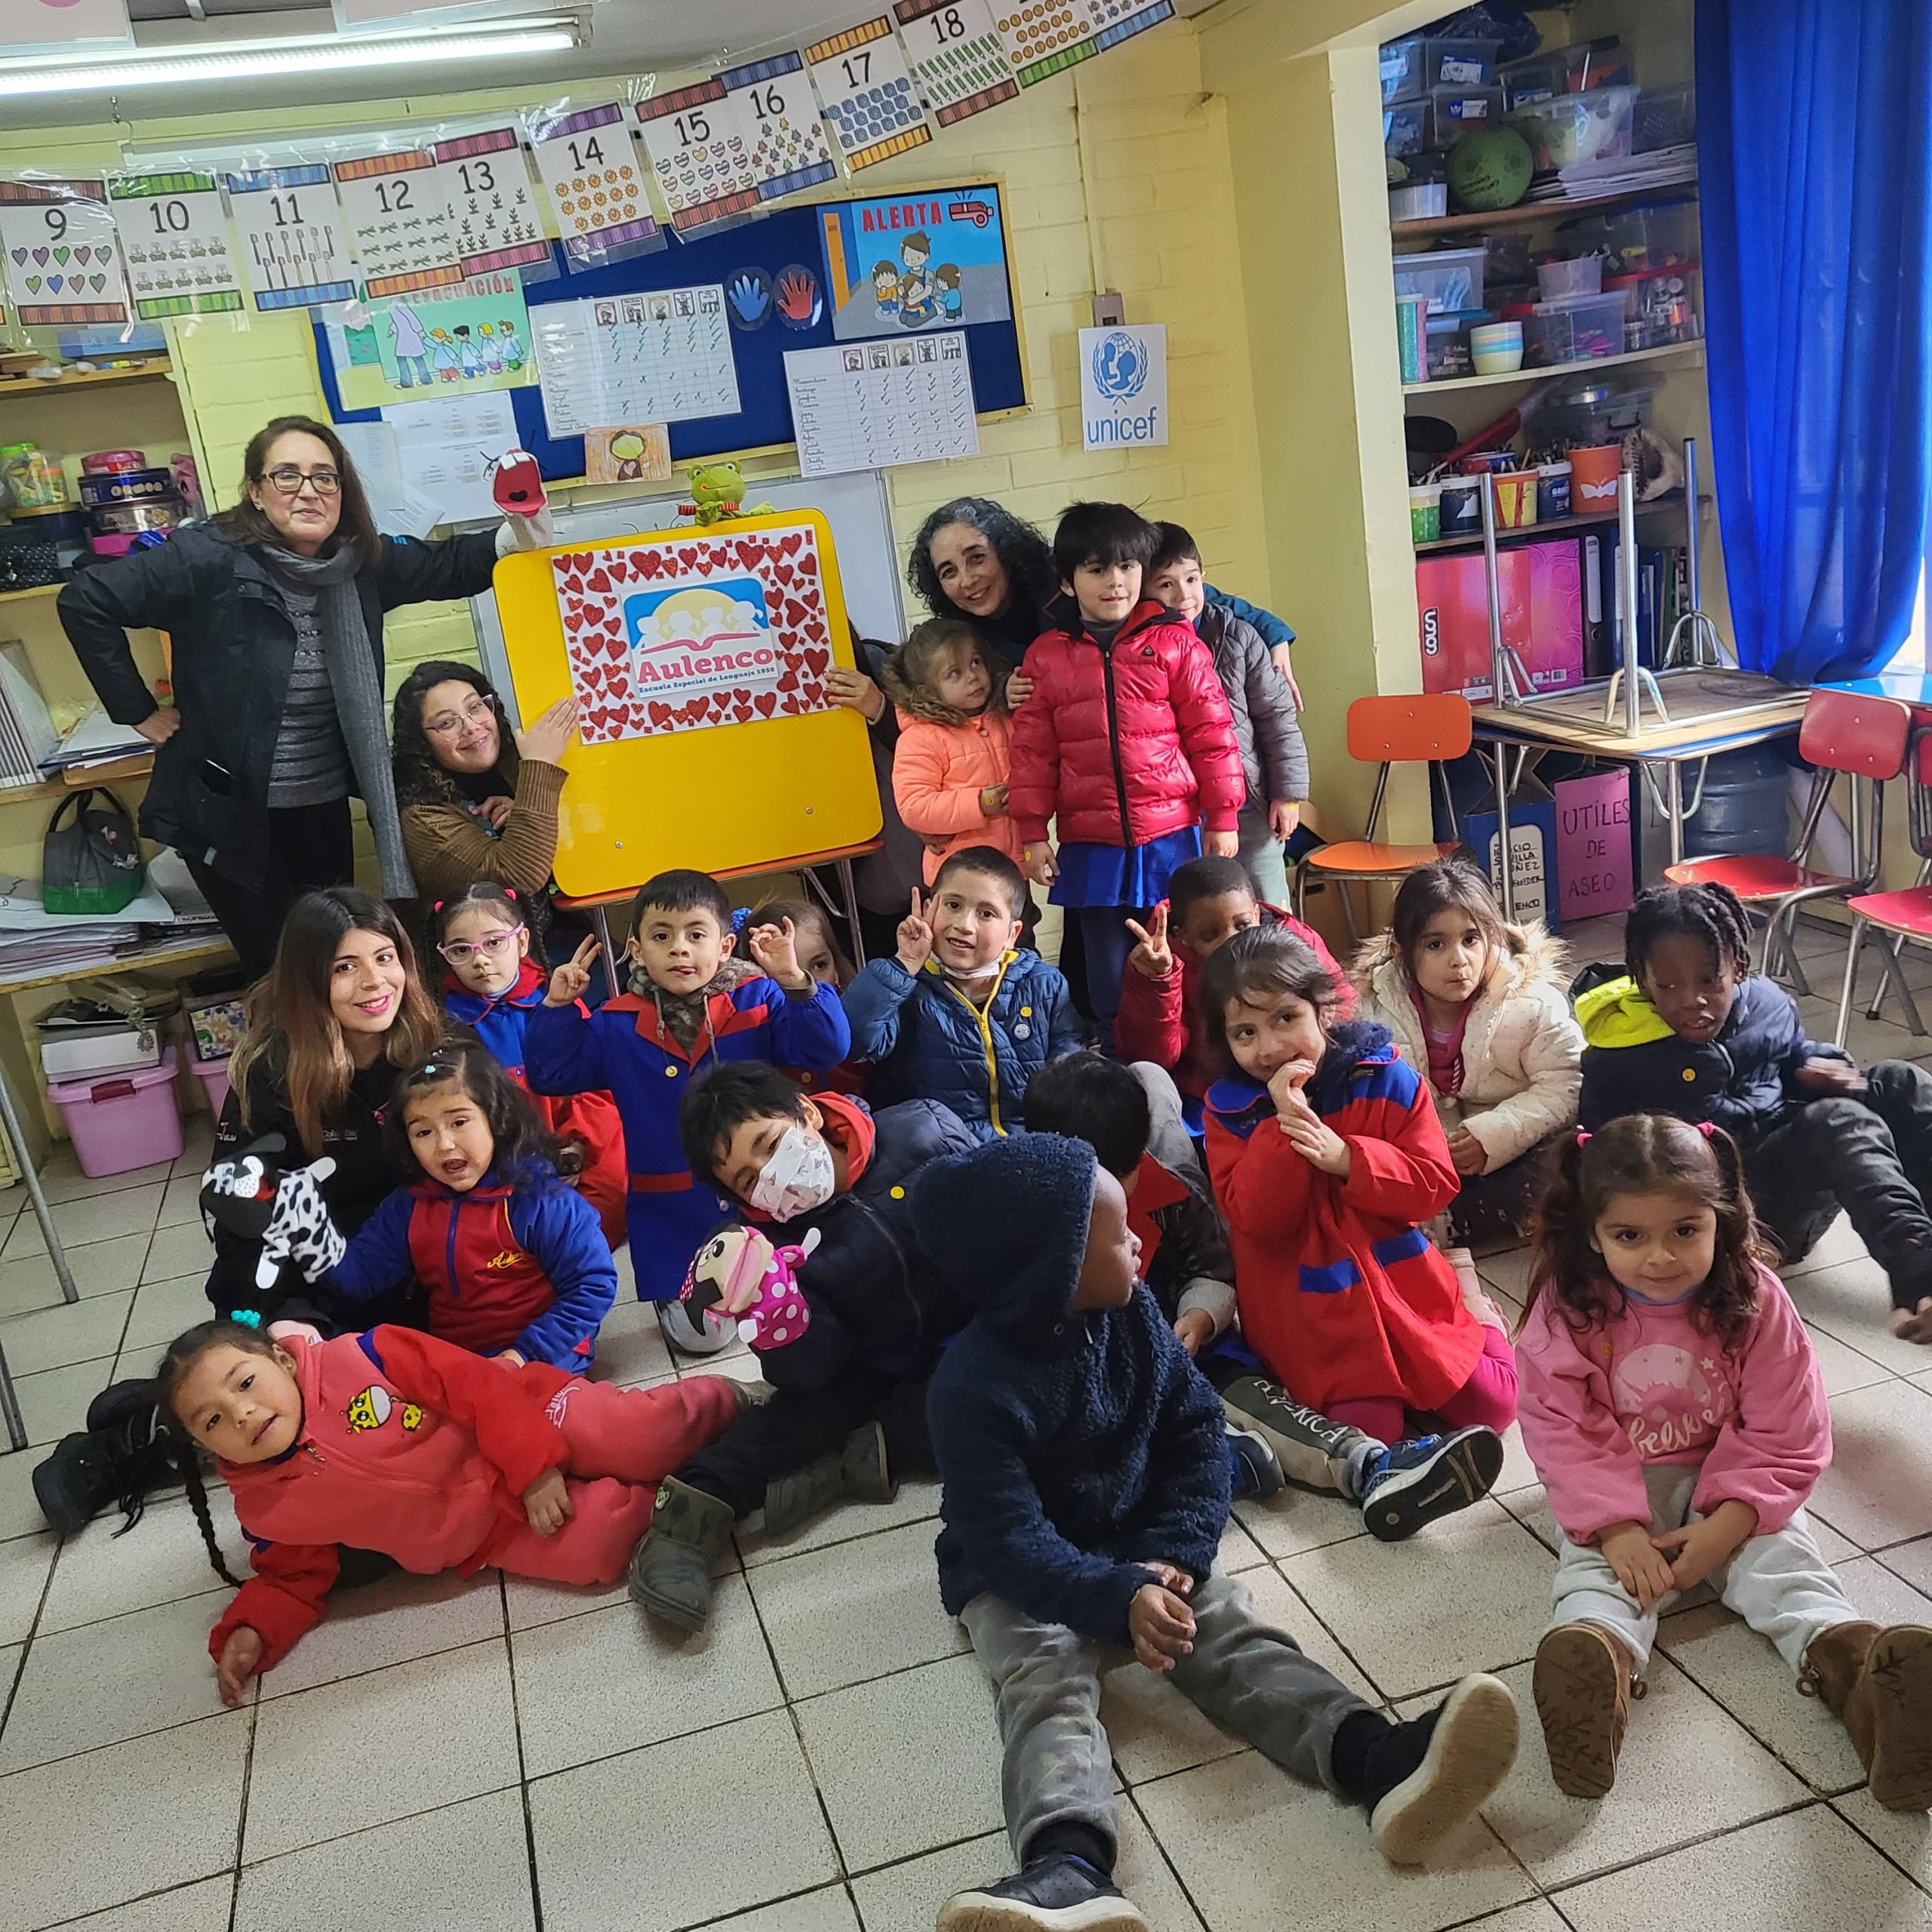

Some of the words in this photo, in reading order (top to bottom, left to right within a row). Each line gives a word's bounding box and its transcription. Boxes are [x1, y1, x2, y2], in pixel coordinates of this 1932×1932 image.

[930, 8, 965, 45] 18
[841, 51, 872, 89] 17
[749, 84, 786, 120] 16
[673, 110, 711, 147] 15
[567, 136, 605, 171] 14
[457, 160, 495, 195] 13
[269, 192, 305, 226] 11
[374, 180, 414, 213] 12
[44, 208, 67, 242] 9
[149, 200, 190, 234] 10
[861, 200, 943, 233] ALERTA
[1087, 405, 1158, 445] unicef
[637, 648, 774, 684] Aulenco
[638, 684, 672, 694] Escuela
[672, 678, 706, 689] Especial
[719, 670, 755, 681] Lenguaje
[1586, 839, 1607, 859] DE
[1568, 872, 1615, 899] ASEO
